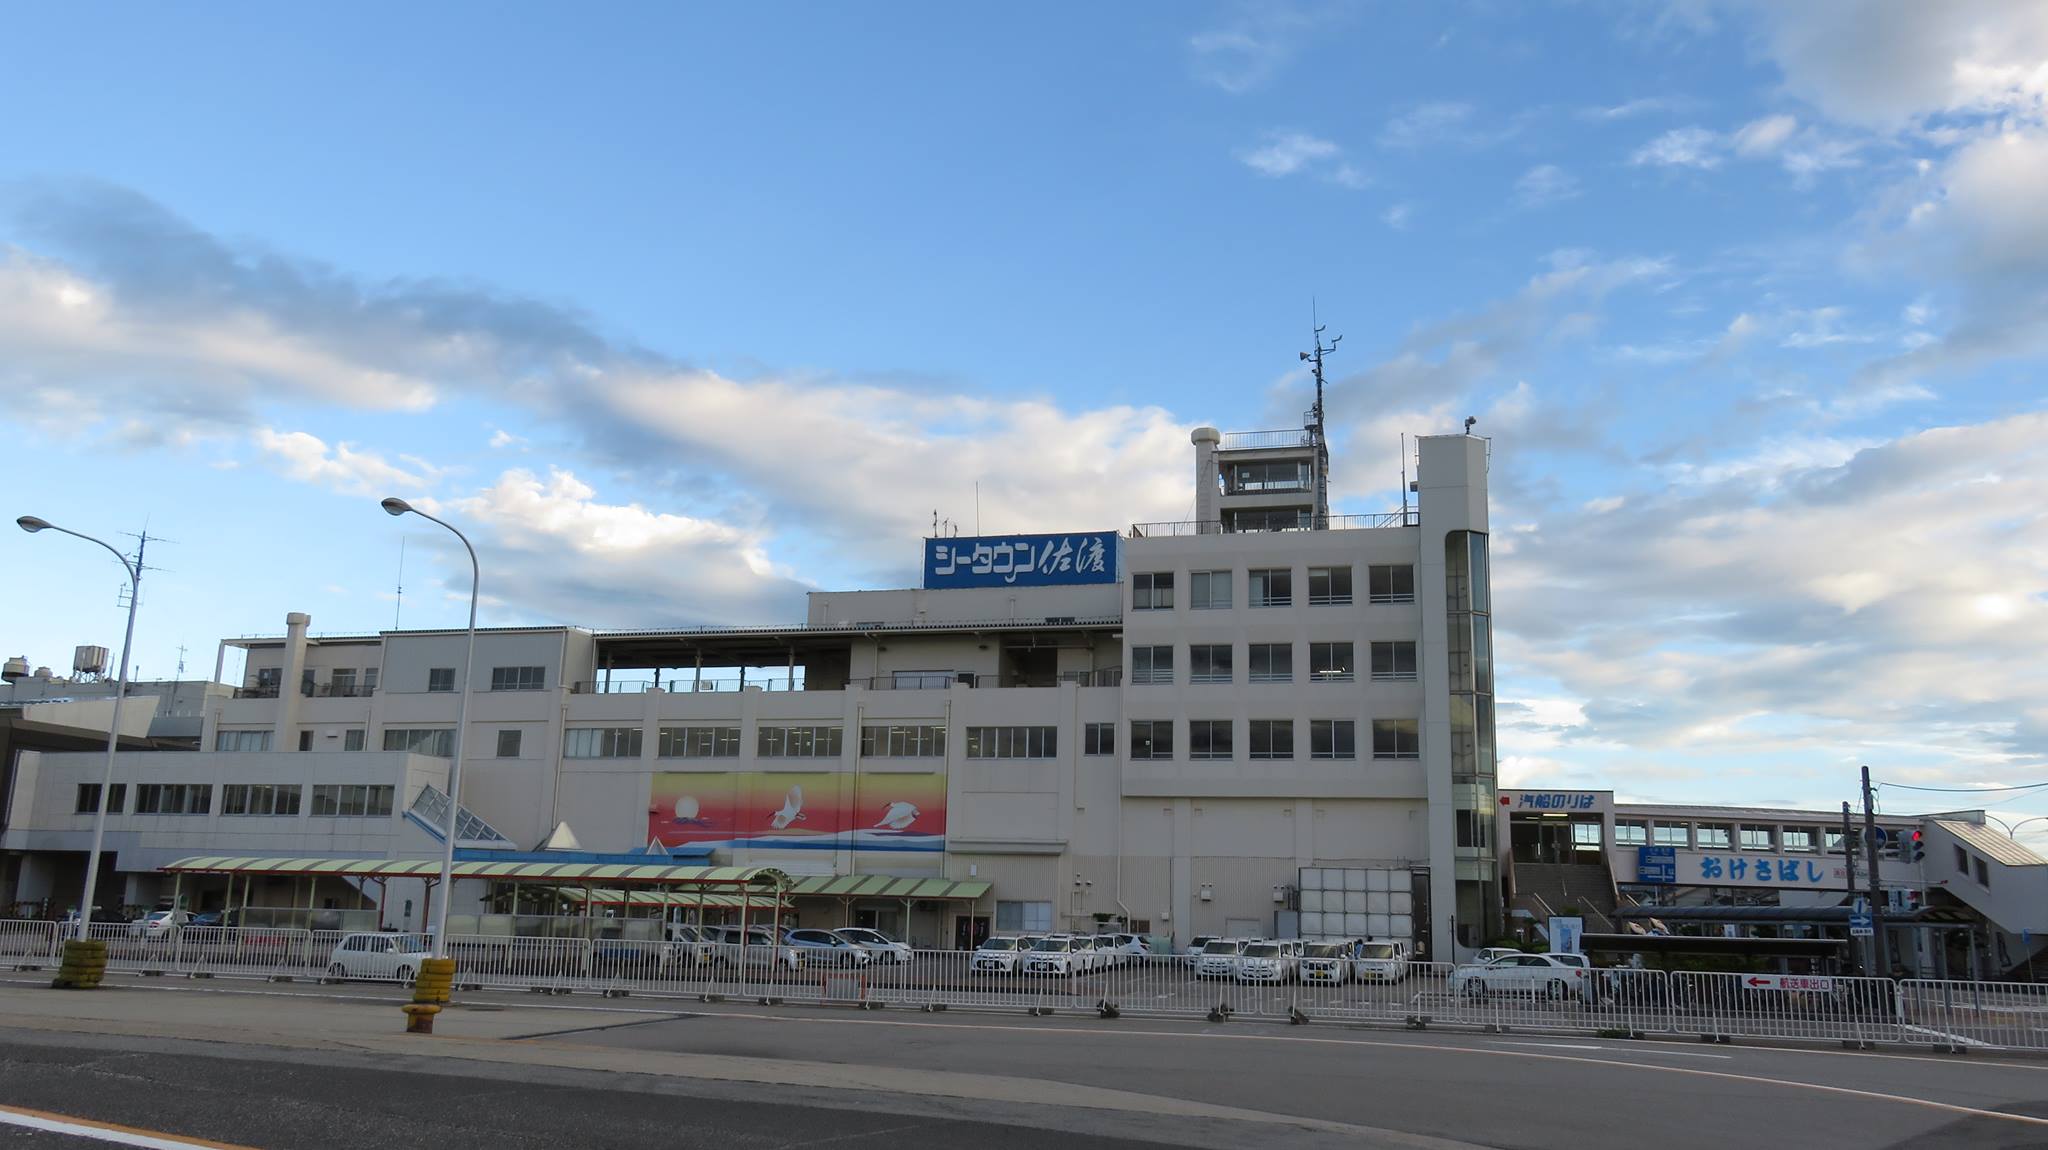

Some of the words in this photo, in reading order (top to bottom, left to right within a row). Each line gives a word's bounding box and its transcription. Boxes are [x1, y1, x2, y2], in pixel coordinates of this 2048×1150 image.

[935, 537, 1105, 583] シータウン佐渡
[1518, 794, 1595, 809] 汽船のりば
[1701, 856, 1825, 883] おけさばし
